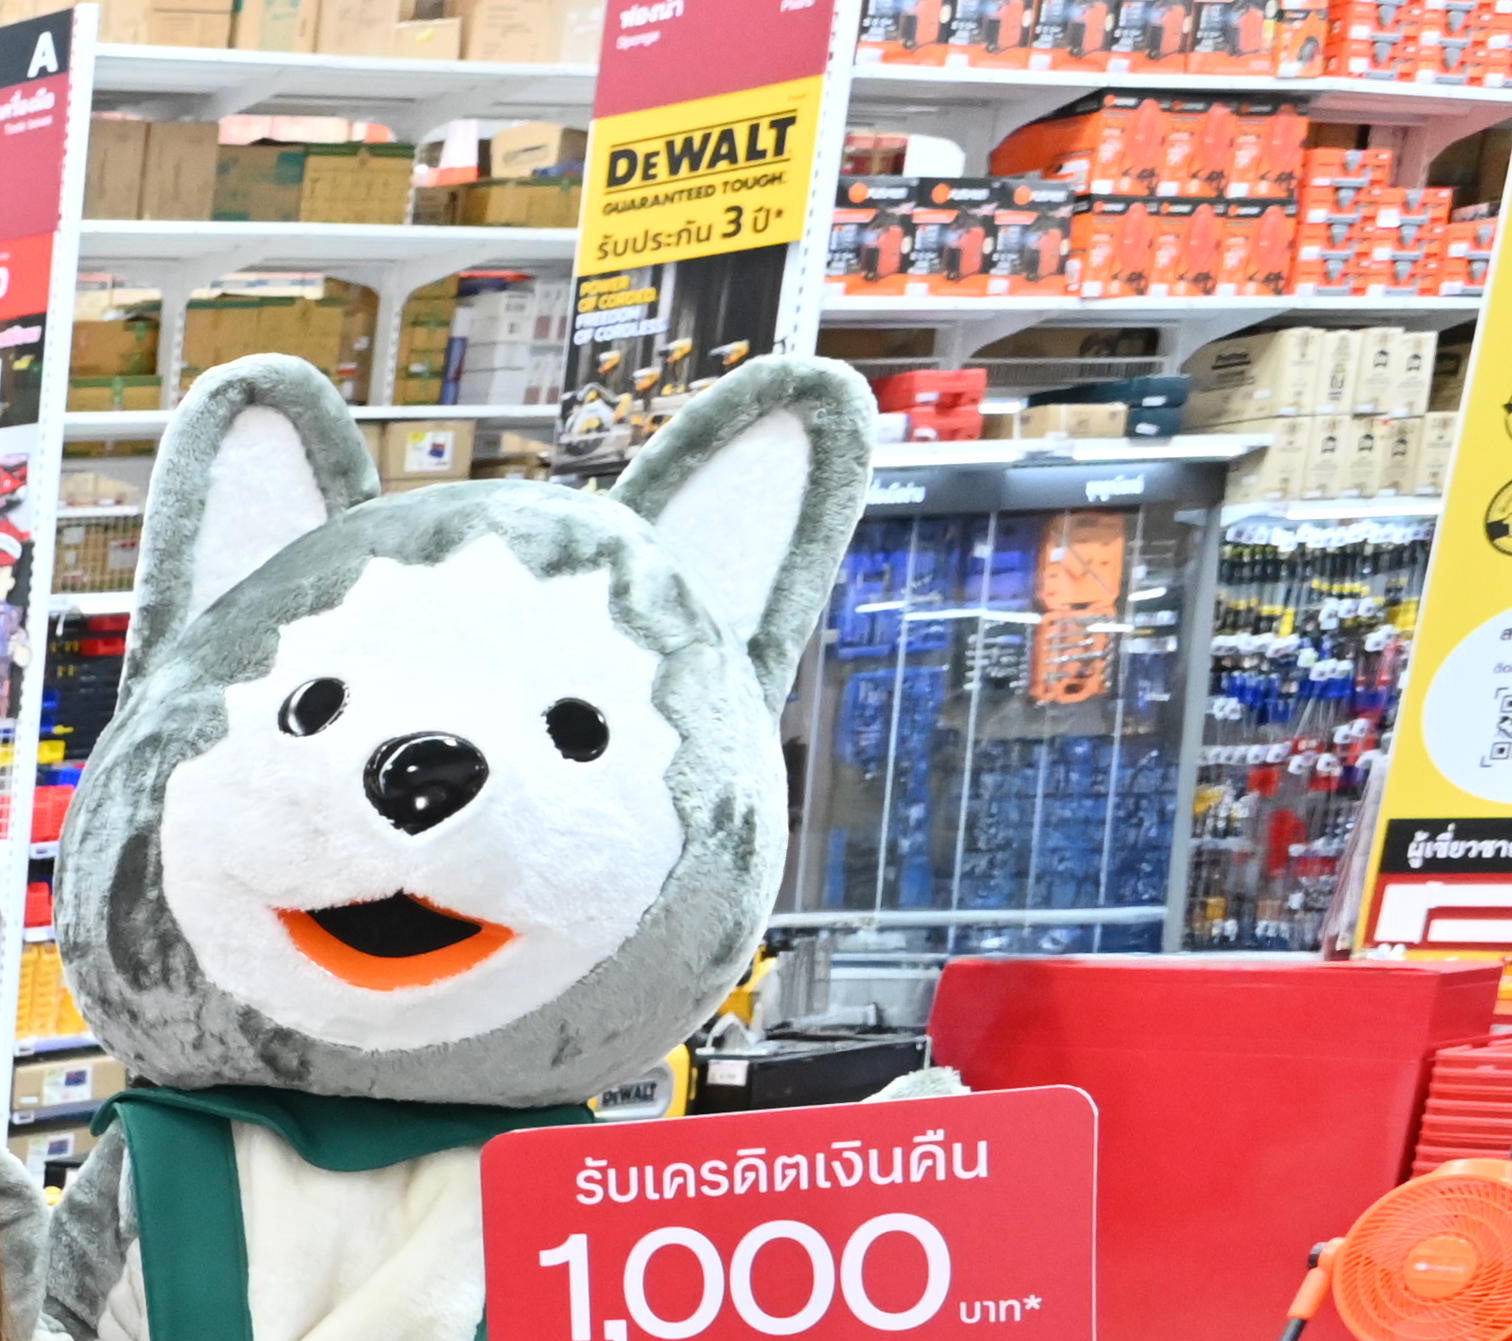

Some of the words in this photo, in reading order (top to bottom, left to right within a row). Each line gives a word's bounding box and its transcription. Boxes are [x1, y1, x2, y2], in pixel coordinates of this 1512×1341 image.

[28, 31, 59, 77] A
[602, 184, 716, 216] GUARANTEED
[597, 219, 713, 261] รับประกัน
[721, 205, 744, 239] 3
[574, 1128, 989, 1206] รับเครดิตเงินคืน
